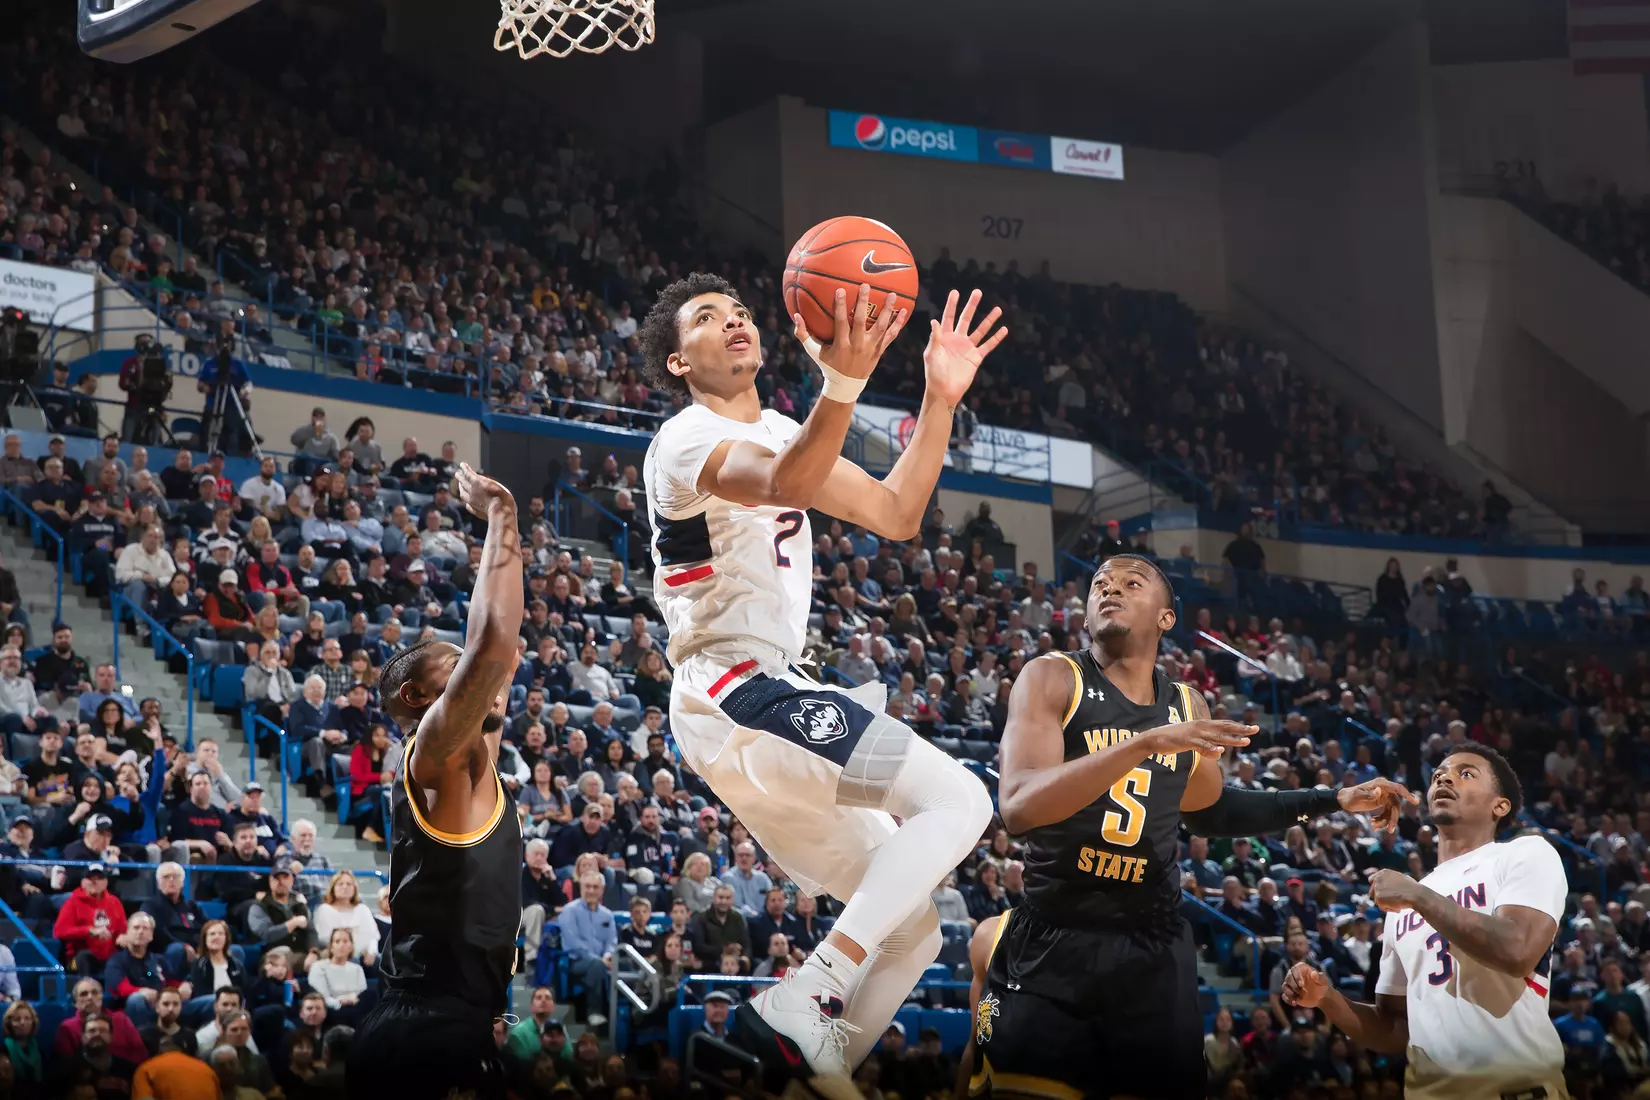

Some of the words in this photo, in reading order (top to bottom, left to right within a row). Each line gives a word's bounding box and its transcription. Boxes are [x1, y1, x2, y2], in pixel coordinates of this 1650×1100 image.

[890, 126, 957, 152] pepsi
[982, 214, 1024, 239] 207
[3, 271, 57, 293] doctors
[167, 351, 202, 376] 10
[773, 510, 804, 569] 2
[1101, 766, 1152, 848] 5
[1077, 846, 1148, 884] STATE
[1395, 882, 1487, 942] UCNN
[1425, 931, 1453, 986] 3
